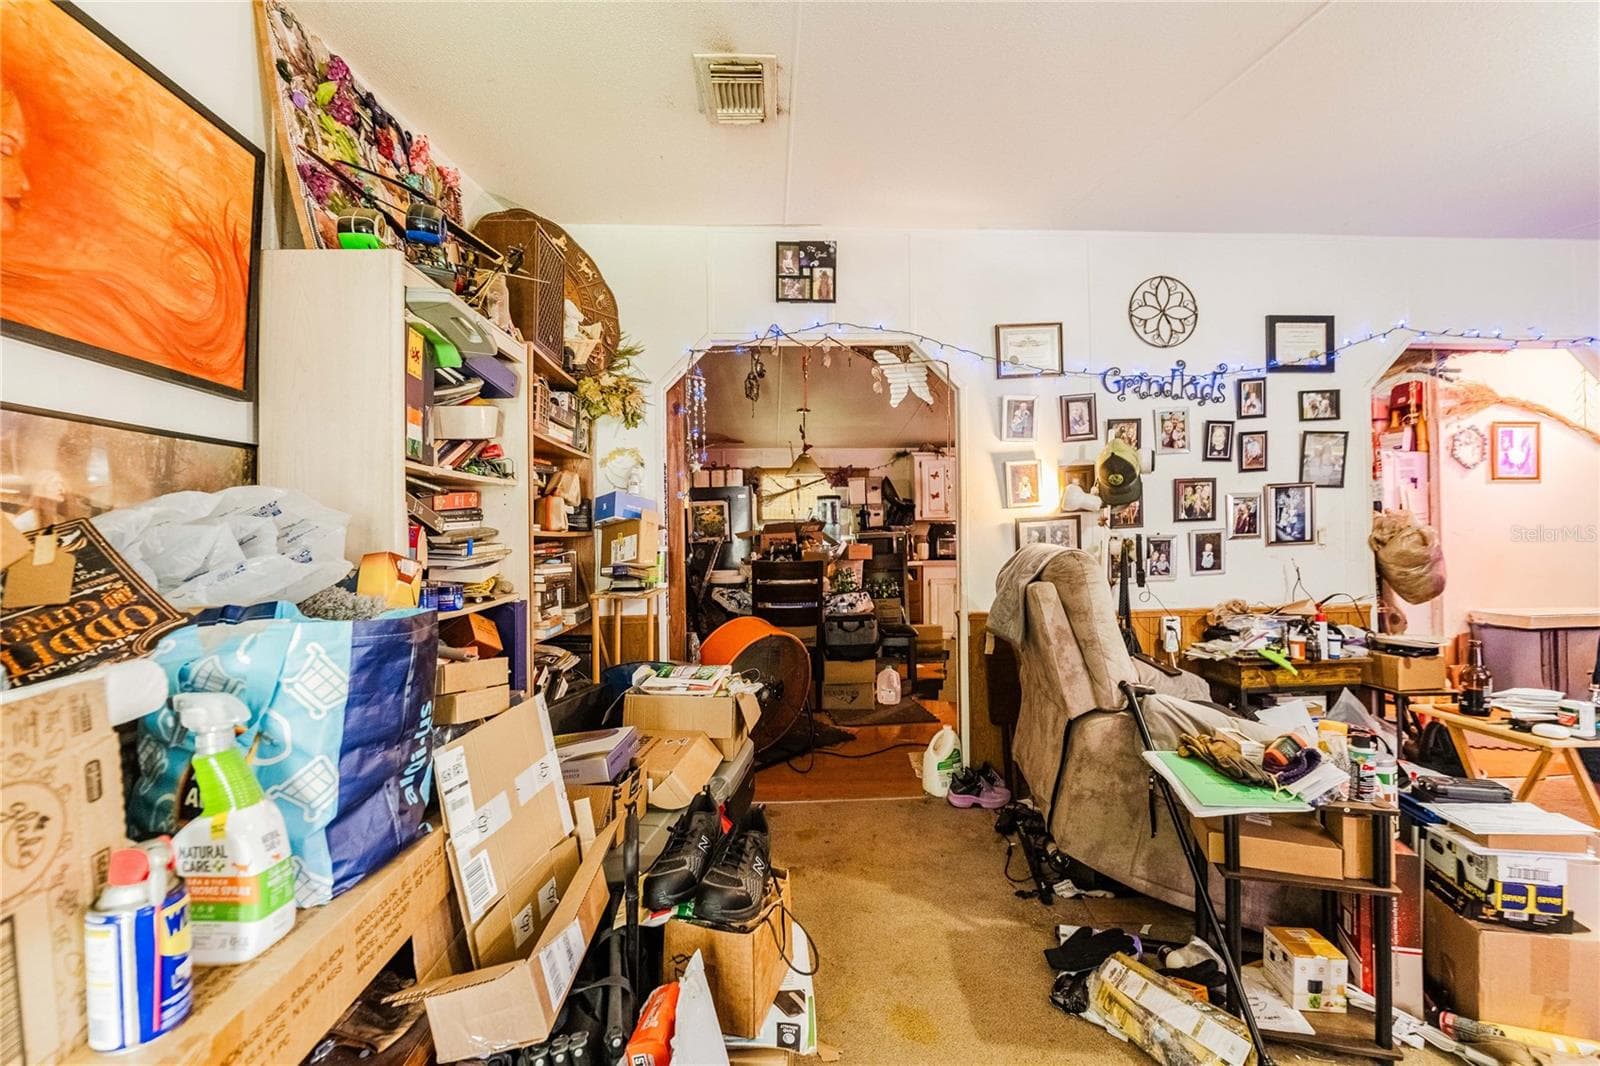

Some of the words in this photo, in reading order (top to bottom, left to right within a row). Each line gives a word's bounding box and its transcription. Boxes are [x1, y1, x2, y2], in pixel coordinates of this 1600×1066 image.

[1101, 359, 1226, 406] Grandkids
[179, 845, 228, 859] NATURAL
[182, 861, 211, 873] CARE
[1502, 894, 1527, 904] SPAM
[1537, 896, 1561, 905] SPAM
